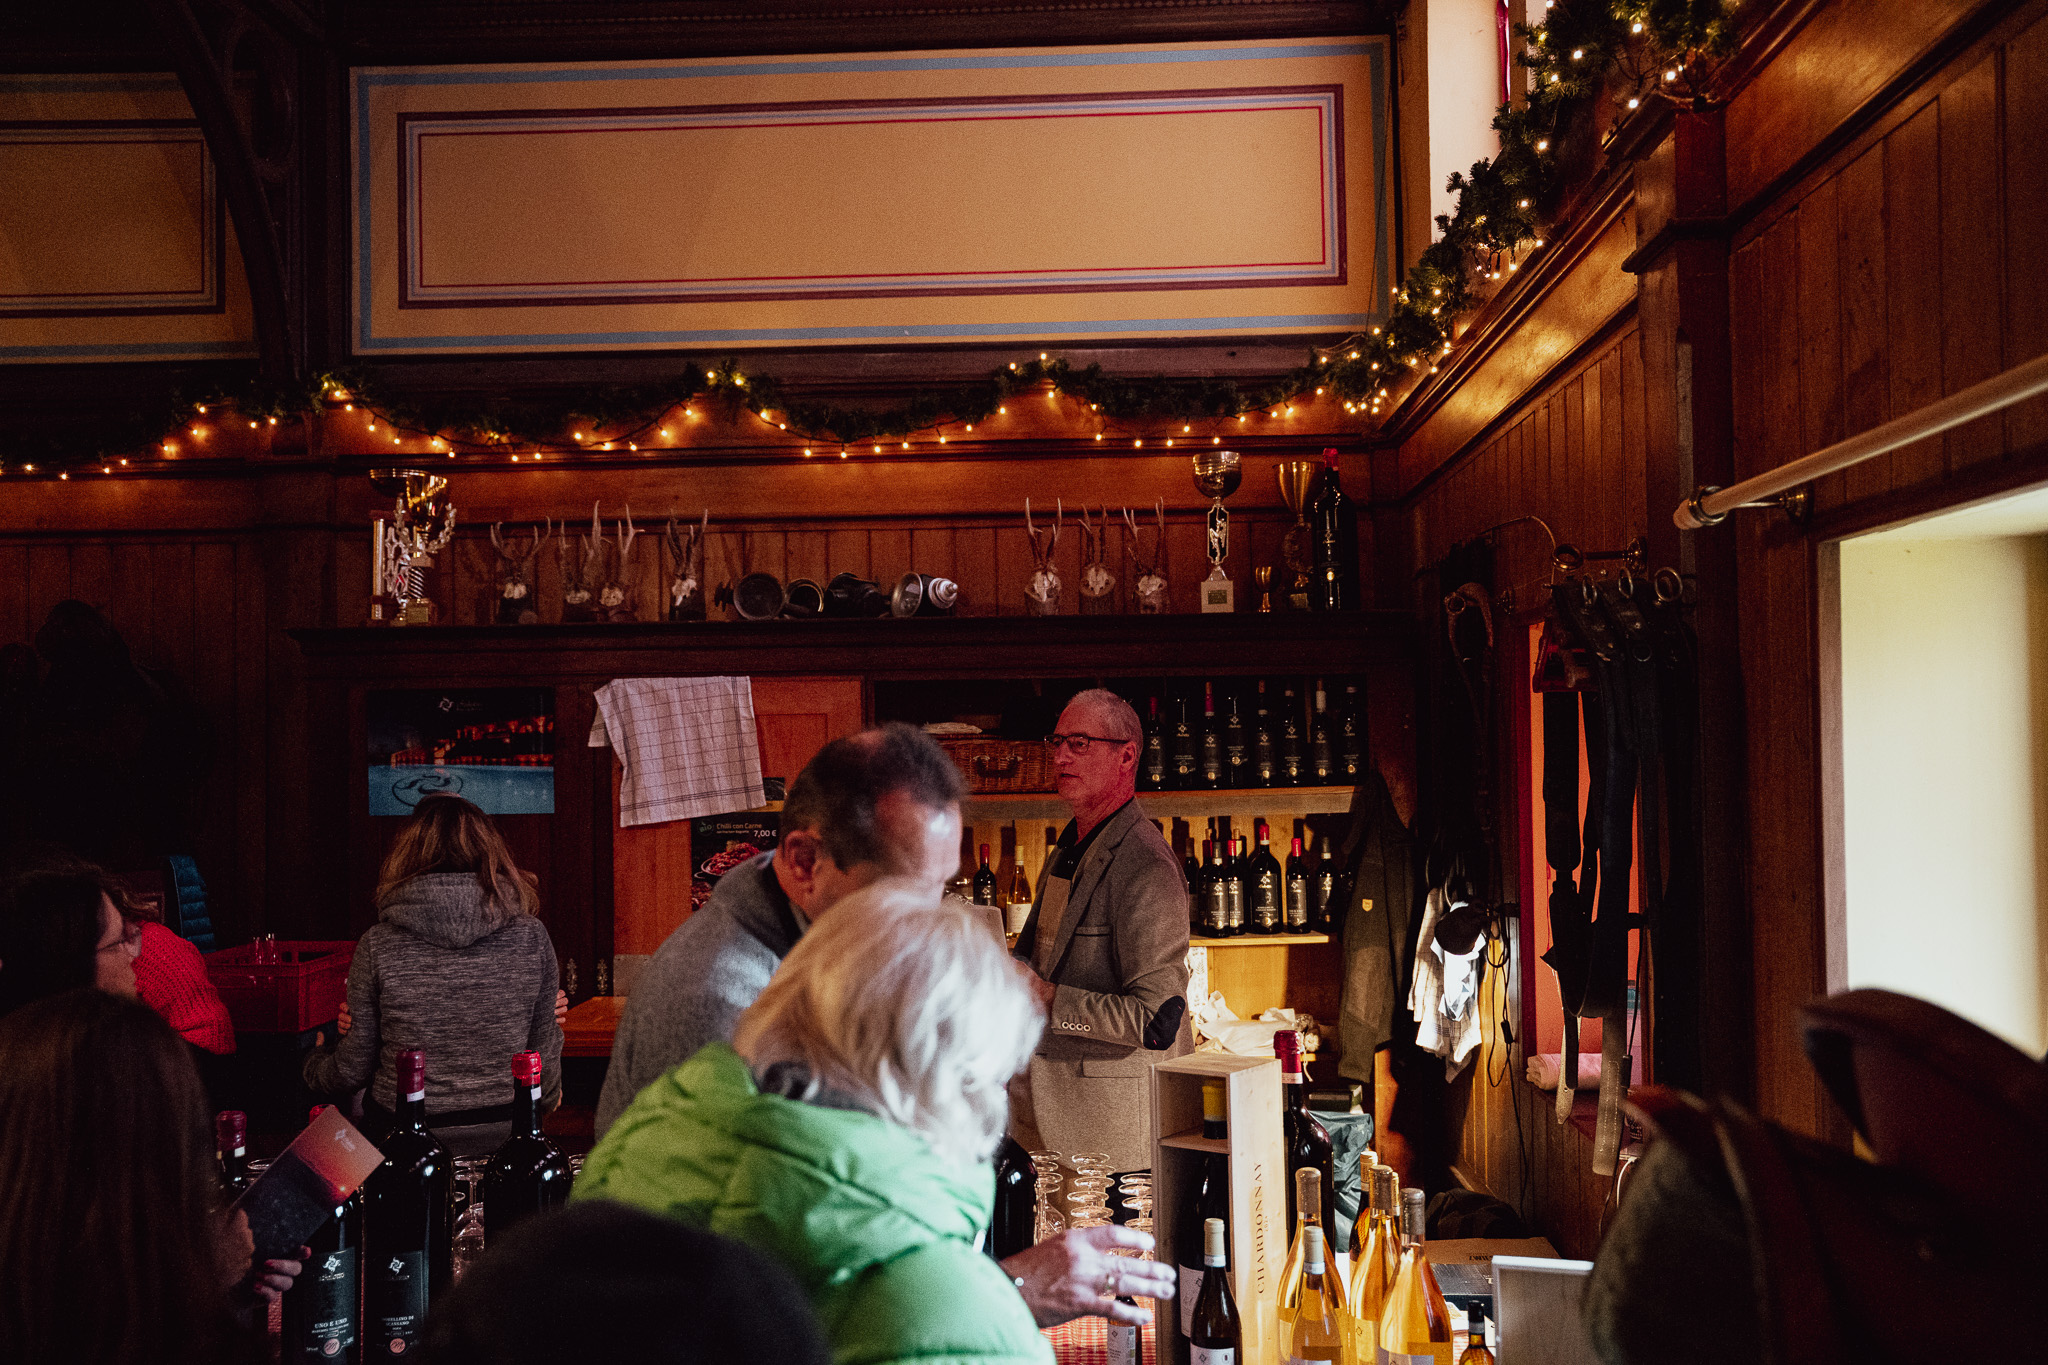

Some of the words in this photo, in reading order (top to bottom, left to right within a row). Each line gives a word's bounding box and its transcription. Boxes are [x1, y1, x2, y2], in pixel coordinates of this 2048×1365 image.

[744, 822, 763, 830] Carne
[753, 829, 771, 838] 7,00
[1254, 1163, 1265, 1294] CHARDONNAY
